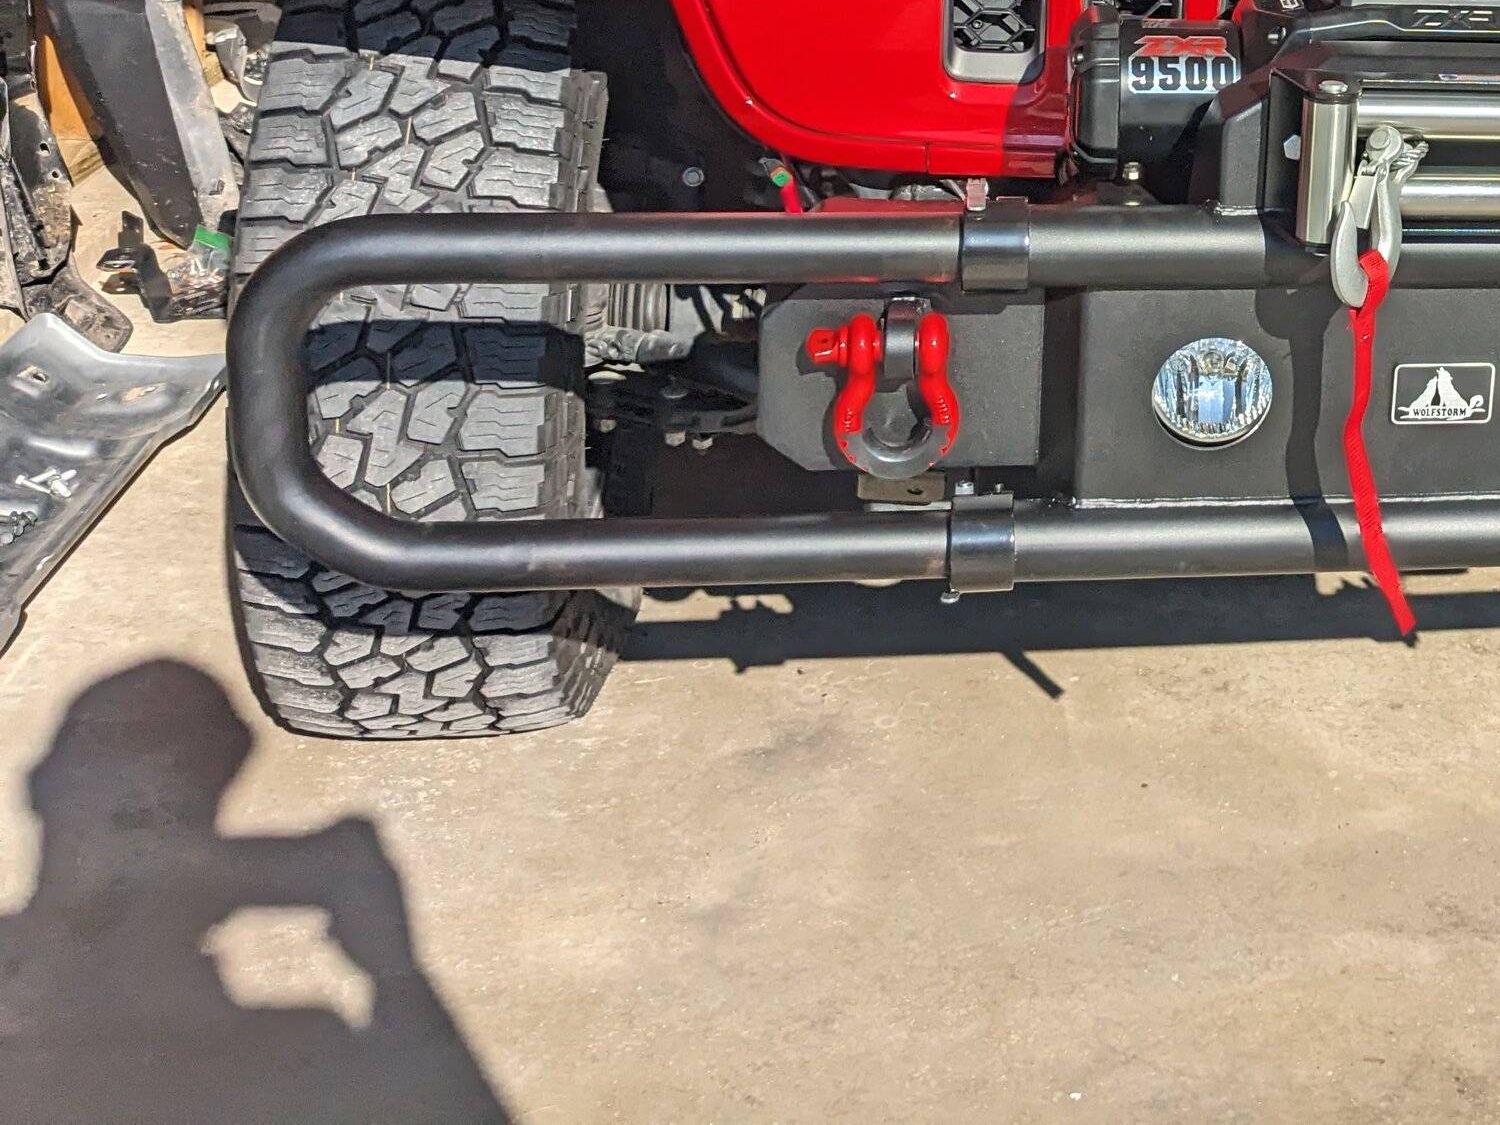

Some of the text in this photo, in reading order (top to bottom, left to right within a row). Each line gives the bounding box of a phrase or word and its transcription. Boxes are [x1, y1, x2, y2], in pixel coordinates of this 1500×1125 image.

[1133, 35, 1229, 57] ZXR
[1129, 56, 1241, 93] 9500
[1412, 408, 1467, 417] WOLFSTORM
